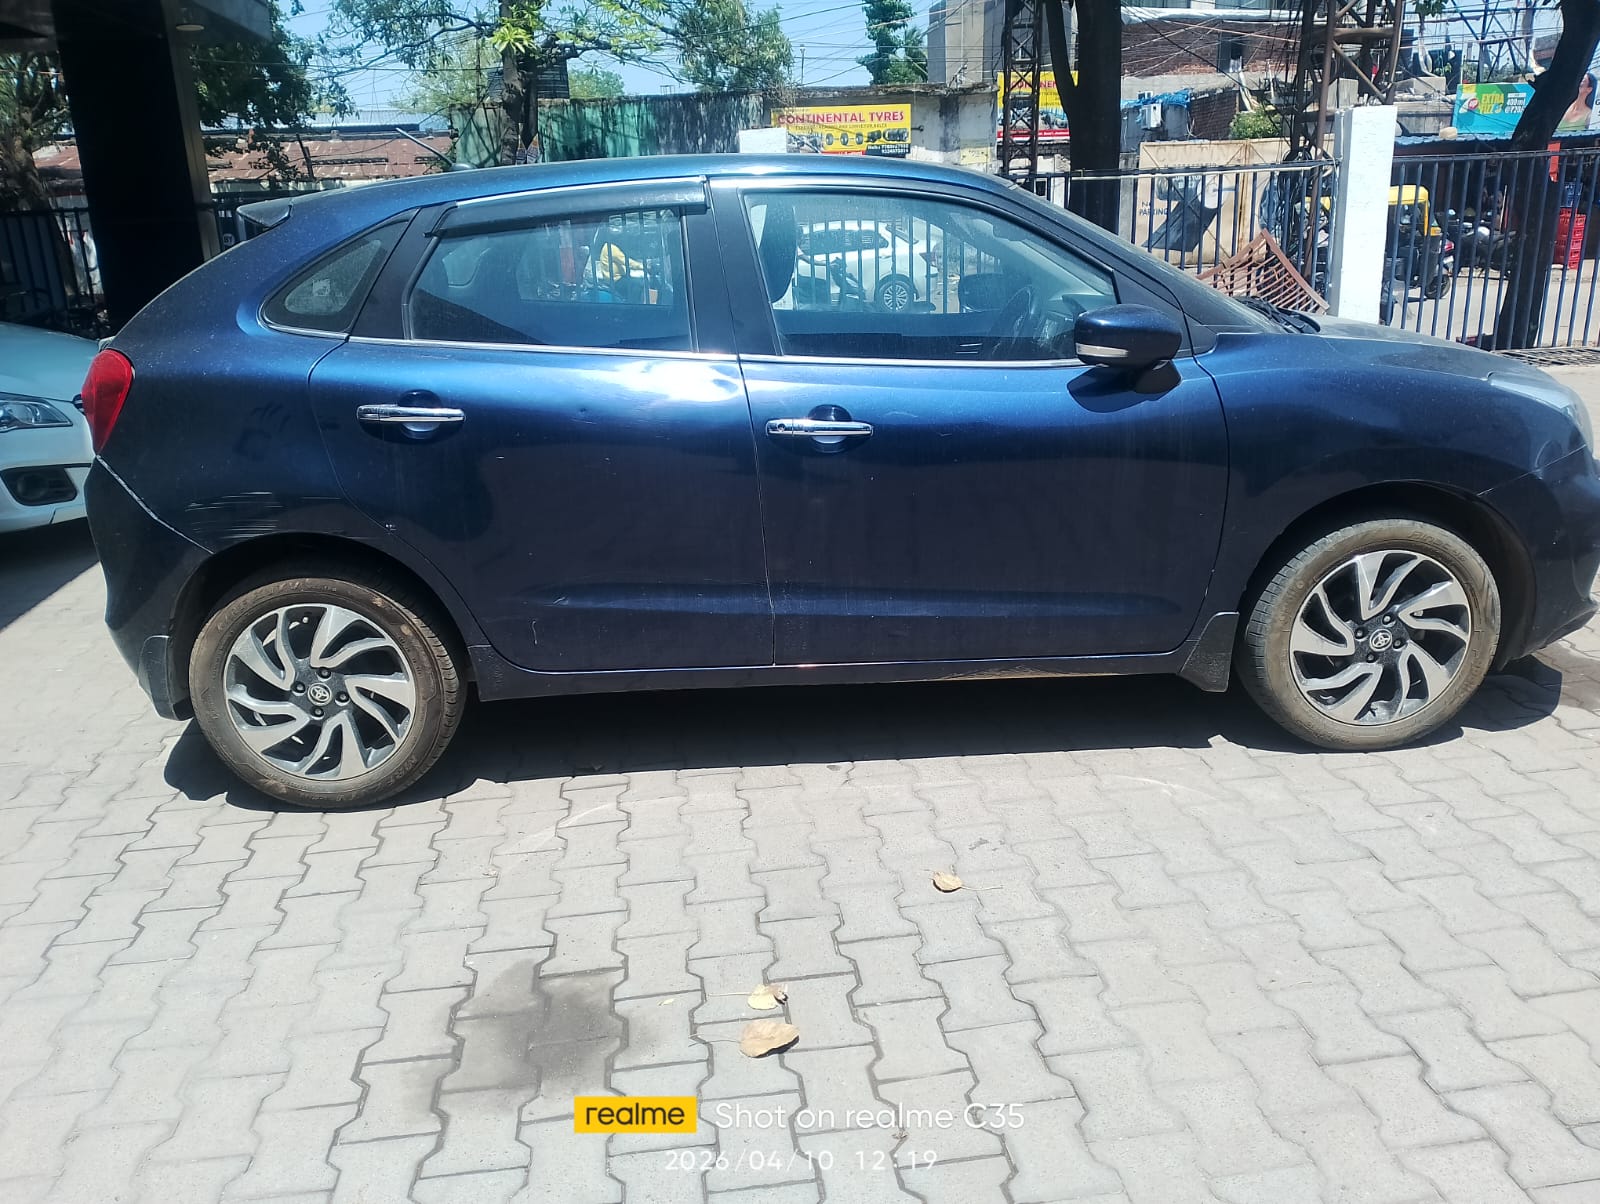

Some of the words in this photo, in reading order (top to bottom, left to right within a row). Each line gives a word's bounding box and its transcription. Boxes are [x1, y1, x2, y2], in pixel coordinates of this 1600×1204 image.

[1481, 93, 1504, 103] EXTRA
[778, 112, 865, 125] CONTINENTAL
[869, 111, 904, 122] TYRES
